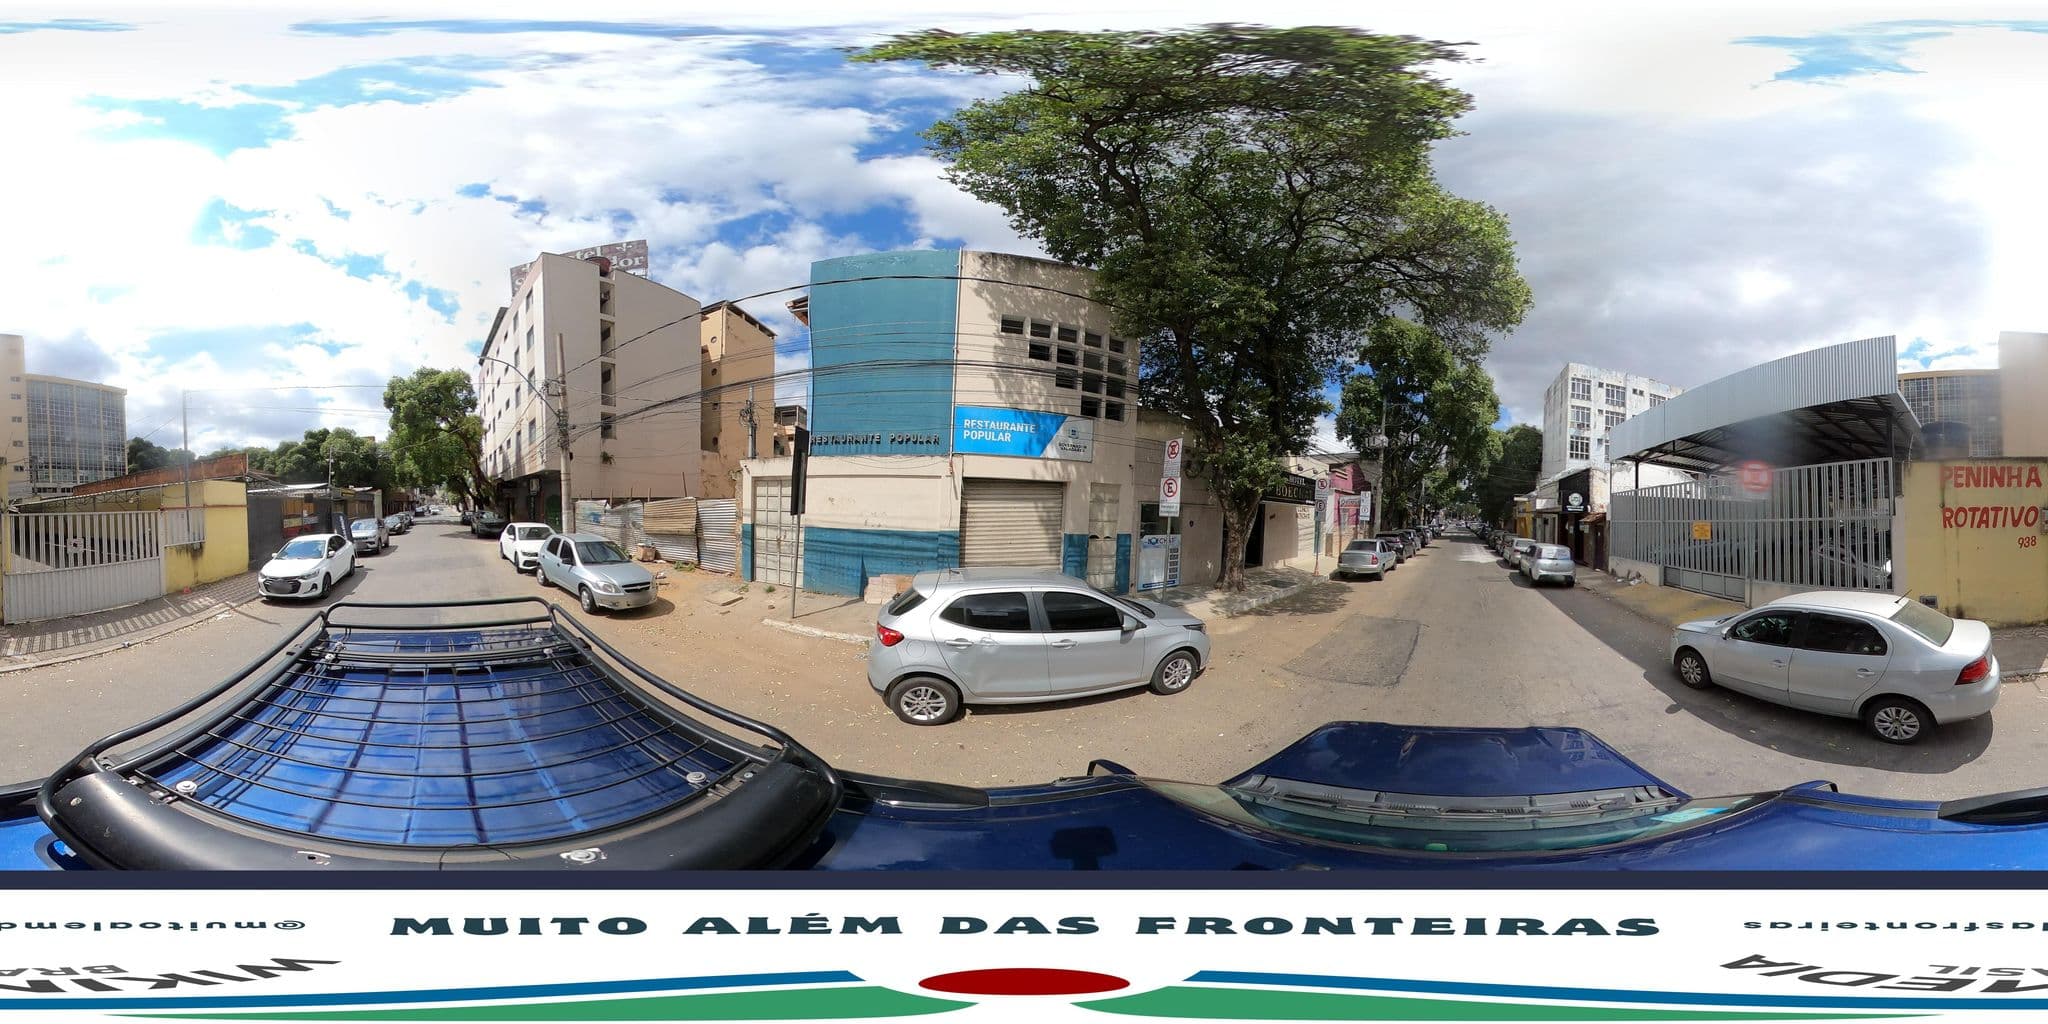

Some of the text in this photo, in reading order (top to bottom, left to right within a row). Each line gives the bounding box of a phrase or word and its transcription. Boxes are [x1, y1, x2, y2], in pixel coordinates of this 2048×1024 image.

[963, 419, 1037, 434] RESTAURANTE
[889, 432, 940, 446] POPULAR
[963, 429, 1012, 442] POPULAR
[1940, 465, 2043, 489] PENINHA
[1942, 506, 2039, 529] ROTATIVO
[2017, 536, 2037, 549] 938
